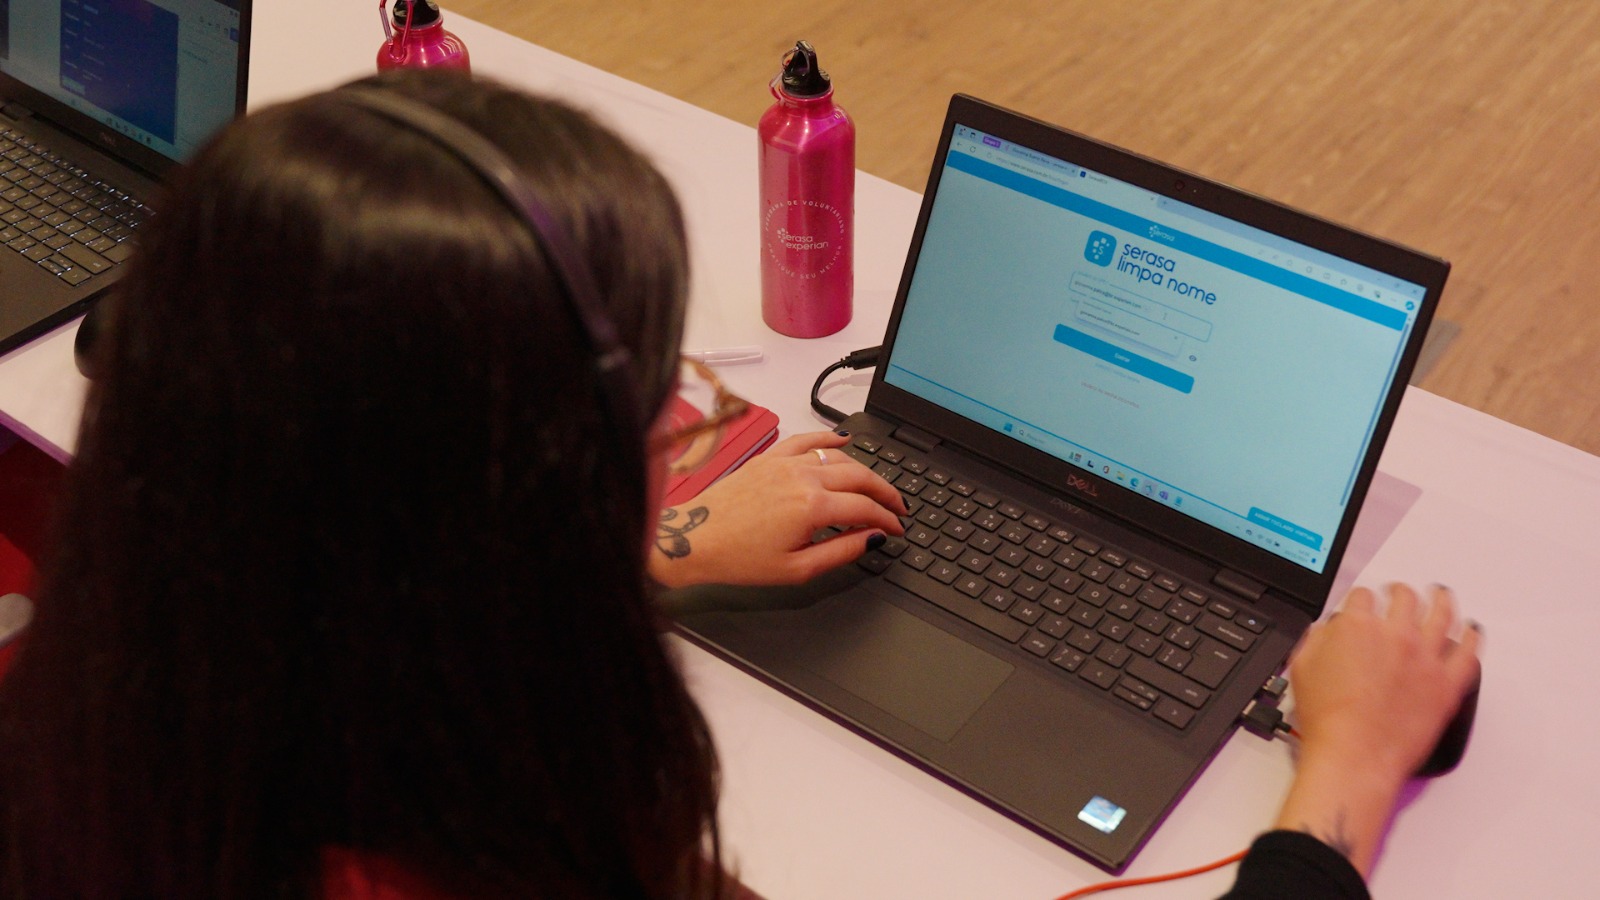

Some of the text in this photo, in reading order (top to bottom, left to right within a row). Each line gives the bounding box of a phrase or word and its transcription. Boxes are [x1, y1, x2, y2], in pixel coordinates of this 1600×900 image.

[802, 201, 844, 234] VOLUNTARIADO
[782, 233, 813, 243] serasa
[786, 241, 828, 251] experian
[1153, 228, 1175, 242] serasa
[820, 245, 841, 274] MELHOR
[1122, 243, 1176, 273] serasa
[1116, 256, 1164, 285] limpa
[1166, 277, 1217, 305] nome
[1066, 473, 1098, 497] DELL
[1022, 608, 1032, 616] M
